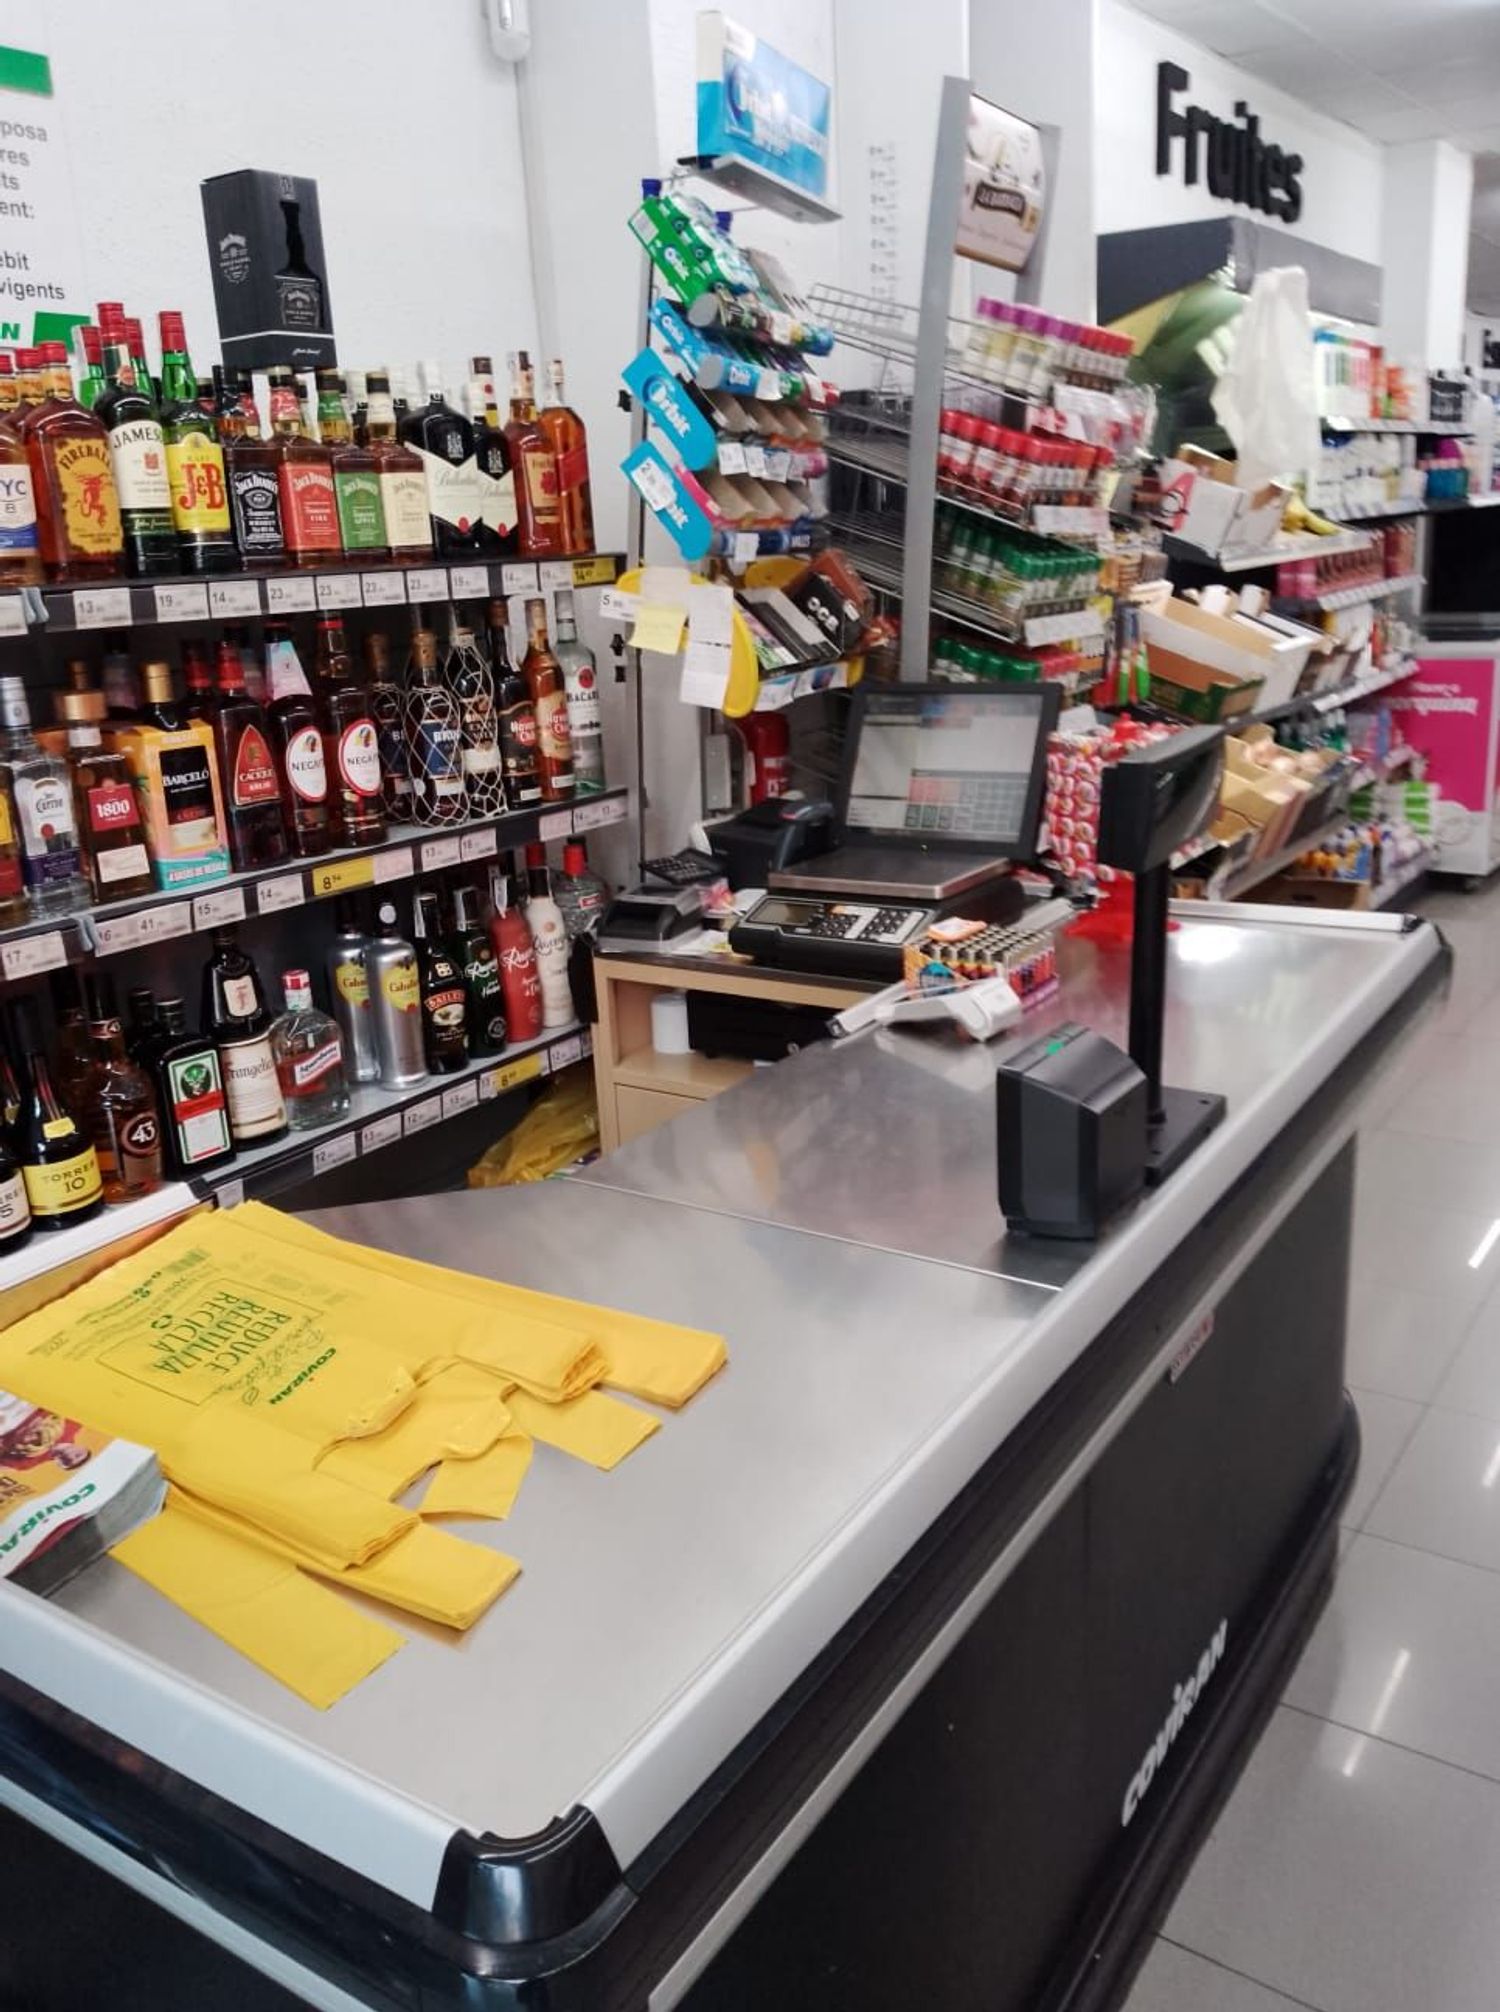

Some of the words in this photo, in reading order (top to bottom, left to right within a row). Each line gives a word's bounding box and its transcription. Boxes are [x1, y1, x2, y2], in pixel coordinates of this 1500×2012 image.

[1156, 60, 1304, 224] Fruites
[96, 799, 131, 818] 1800
[323, 876, 332, 890] 8
[141, 918, 155, 932] 41
[6, 950, 21, 965] 17
[131, 1121, 155, 1143] 43
[148, 1290, 241, 1354] RECICLA
[152, 1300, 267, 1375] REUTILIZA
[203, 1310, 293, 1375] REDUCE
[269, 1346, 337, 1405] COVIRAN
